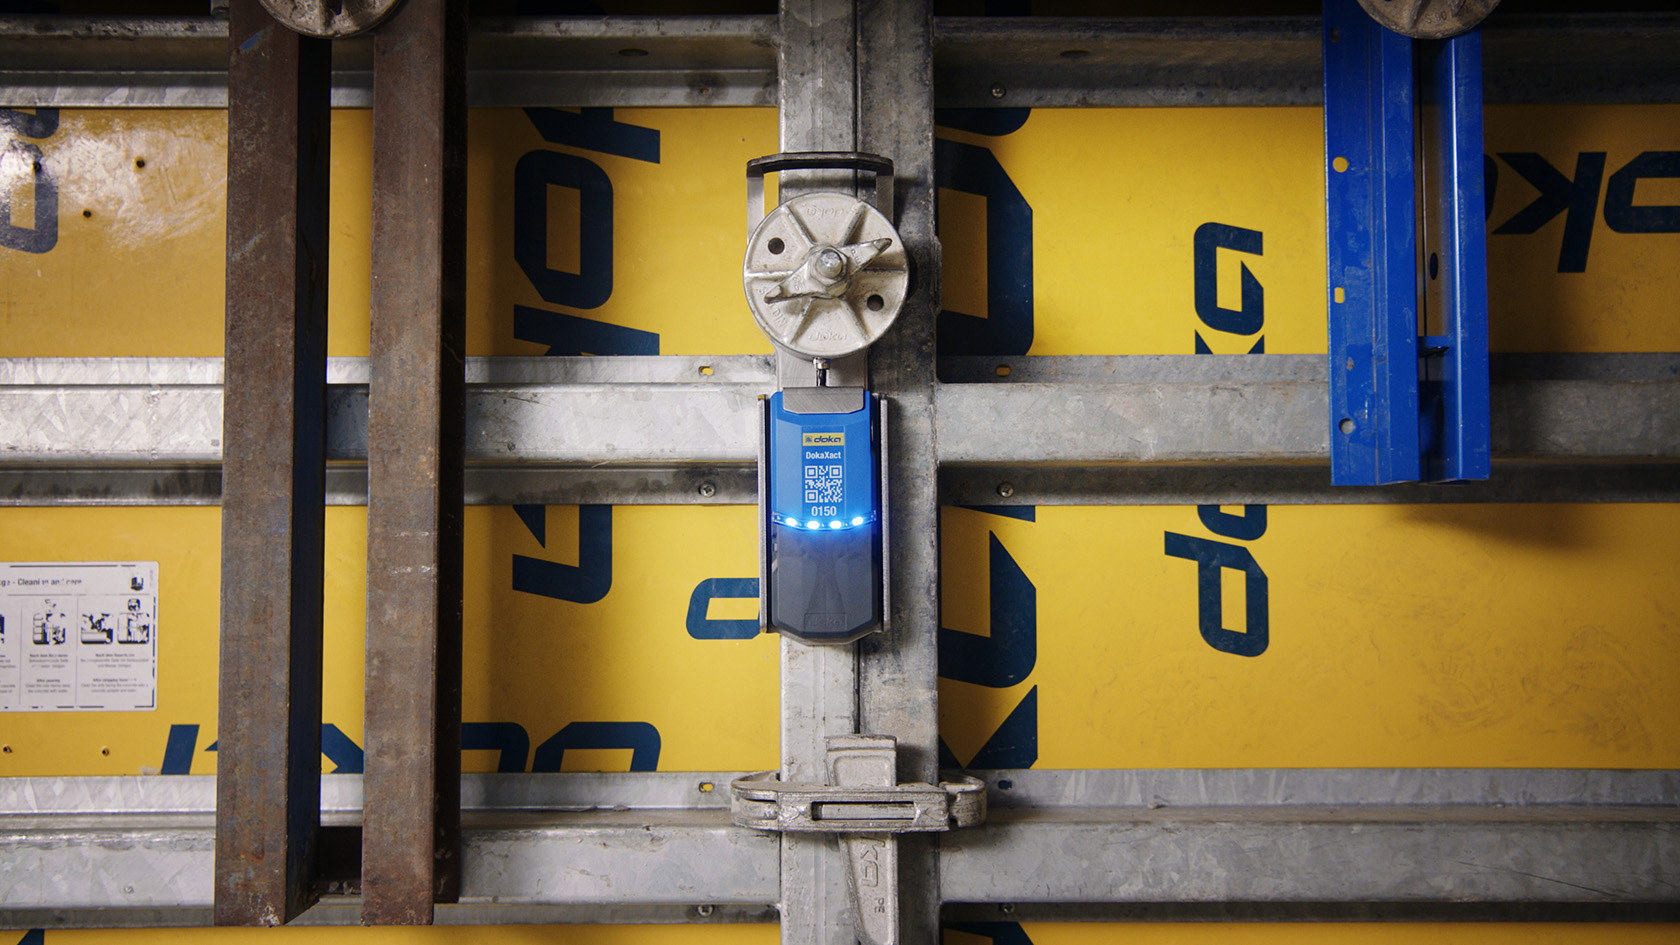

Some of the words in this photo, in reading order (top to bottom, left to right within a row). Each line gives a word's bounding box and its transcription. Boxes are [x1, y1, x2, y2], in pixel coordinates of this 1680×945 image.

[814, 435, 841, 443] doka
[805, 451, 842, 460] DokaXact
[811, 505, 837, 517] 0150
